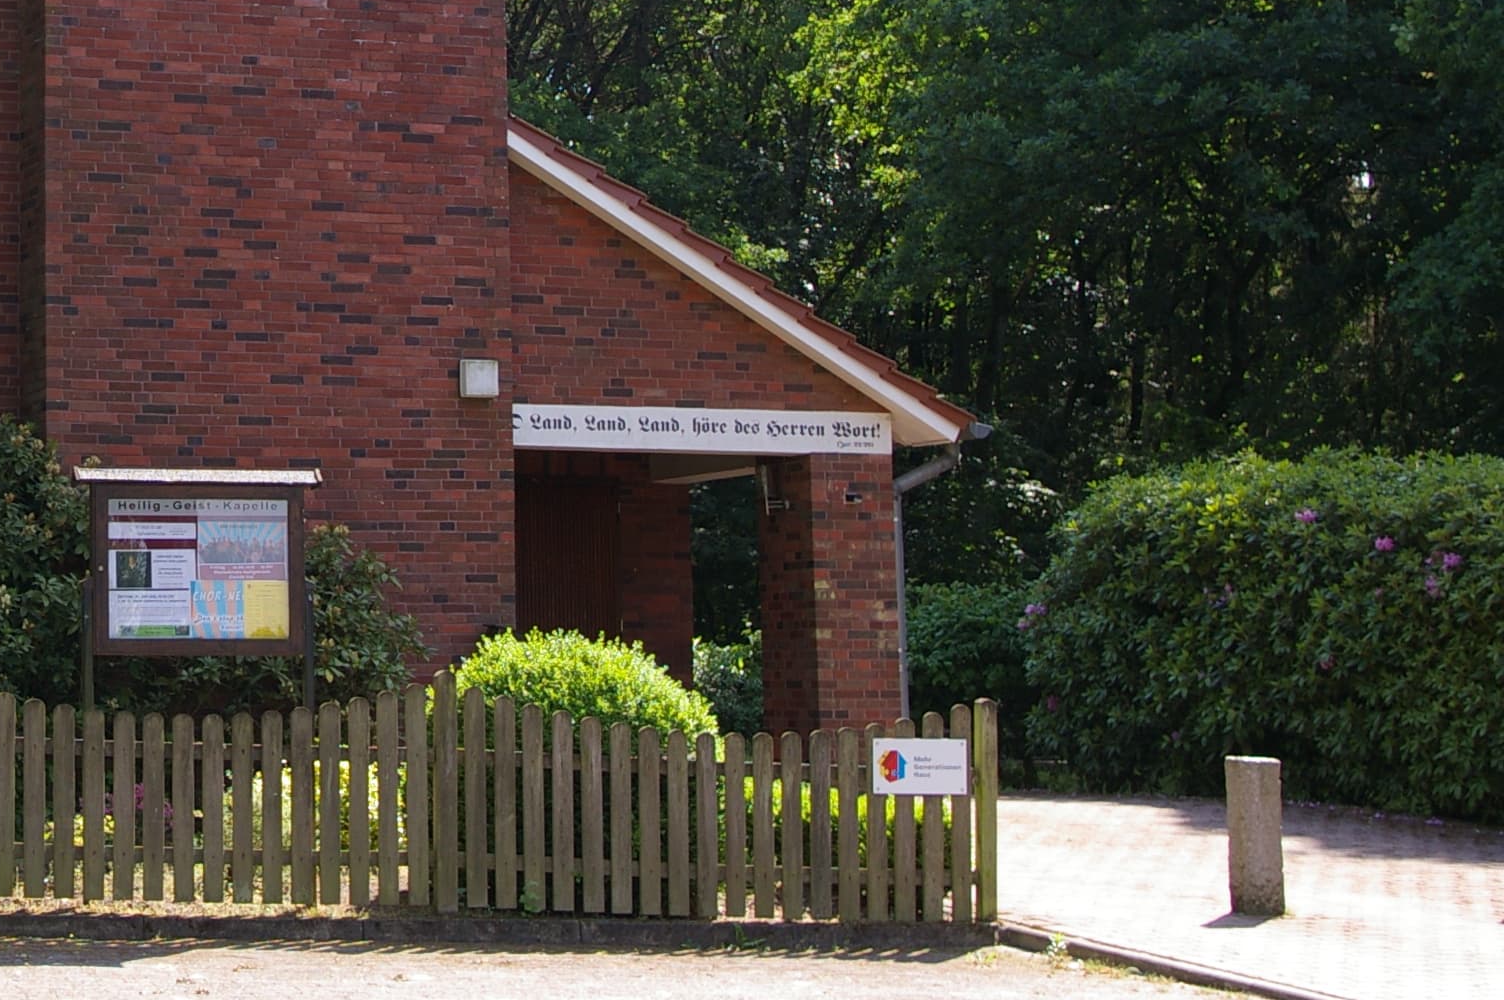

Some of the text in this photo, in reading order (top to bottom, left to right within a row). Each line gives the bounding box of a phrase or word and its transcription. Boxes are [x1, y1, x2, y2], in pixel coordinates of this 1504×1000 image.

[530, 413, 577, 433] Land,
[584, 415, 631, 434] Land,
[638, 416, 685, 436] Land,
[692, 417, 727, 436] höre
[734, 419, 760, 434] des
[766, 420, 825, 437] Herren
[832, 421, 881, 438] Wort!
